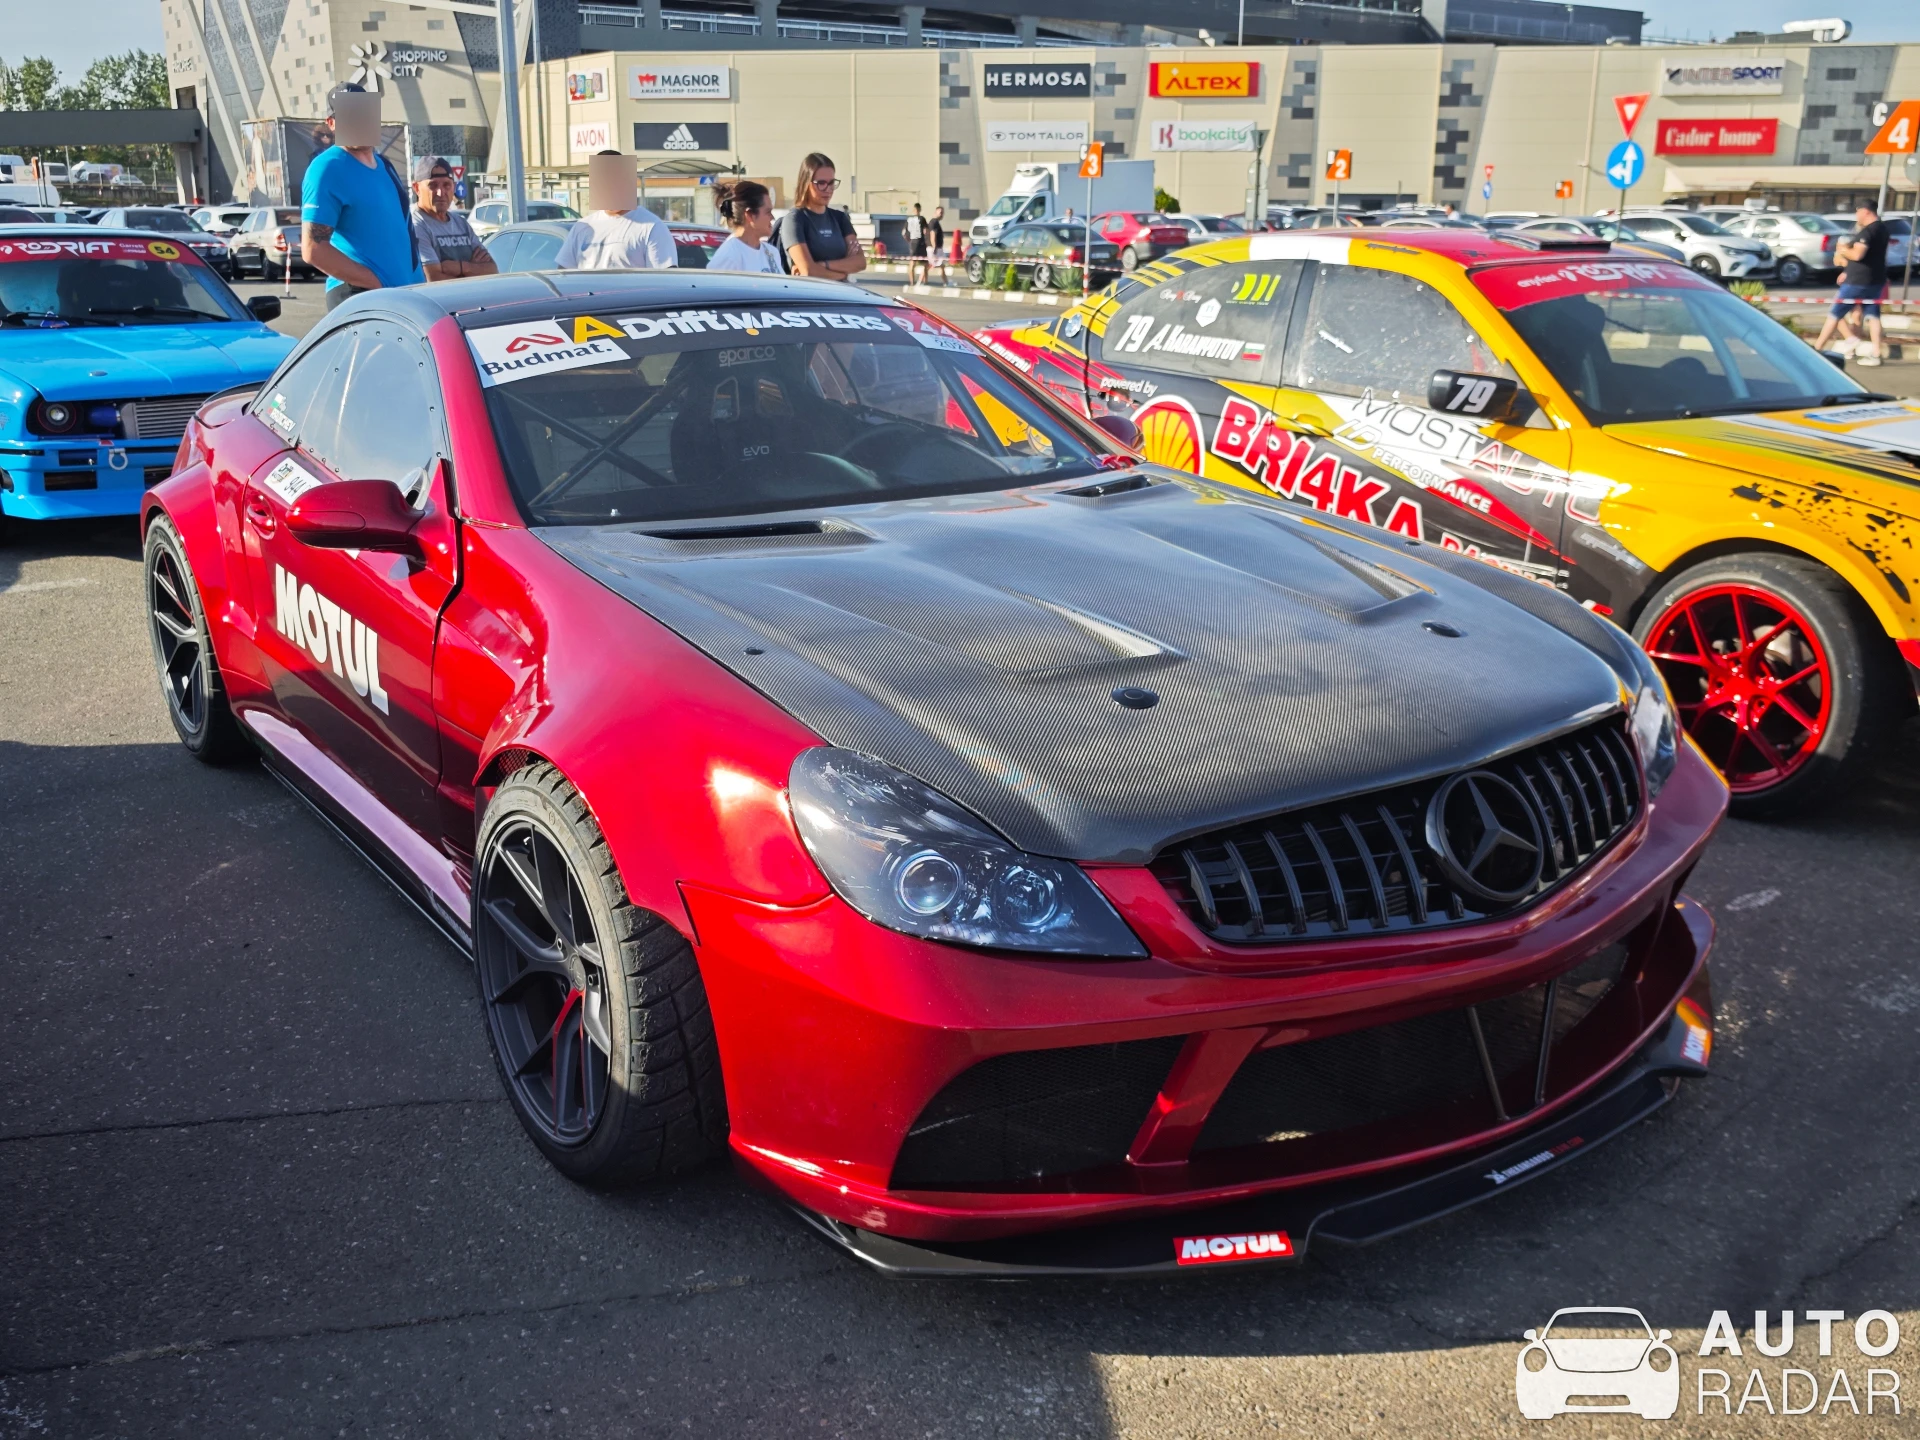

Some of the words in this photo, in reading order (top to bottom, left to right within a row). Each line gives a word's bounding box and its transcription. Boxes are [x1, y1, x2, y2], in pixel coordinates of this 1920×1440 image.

[392, 50, 448, 63] SHOPPING
[393, 64, 420, 77] CITY
[986, 71, 1087, 87] HERMOSA
[1682, 66, 1783, 82] INTERSPORT
[661, 74, 720, 87] MAGNOR
[1872, 102, 1888, 127] C
[1887, 117, 1910, 149] 4
[575, 129, 605, 147] AVON
[663, 139, 700, 150] adidas
[1009, 131, 1036, 141] TOM
[1039, 131, 1085, 141] TAILOR
[1177, 126, 1248, 145] bookcity
[1087, 153, 1099, 176] 3
[1335, 158, 1347, 179] 2
[155, 245, 176, 256] 54
[1114, 314, 1155, 353] 79
[718, 344, 777, 367] sparco
[1100, 377, 1143, 393] powered
[1143, 380, 1159, 398] by
[1446, 376, 1498, 414] 79
[743, 445, 770, 457] EVO
[1371, 446, 1494, 515] PERFORMANCE
[275, 562, 390, 717] MOTUL
[1181, 1233, 1287, 1260] MOTUL
